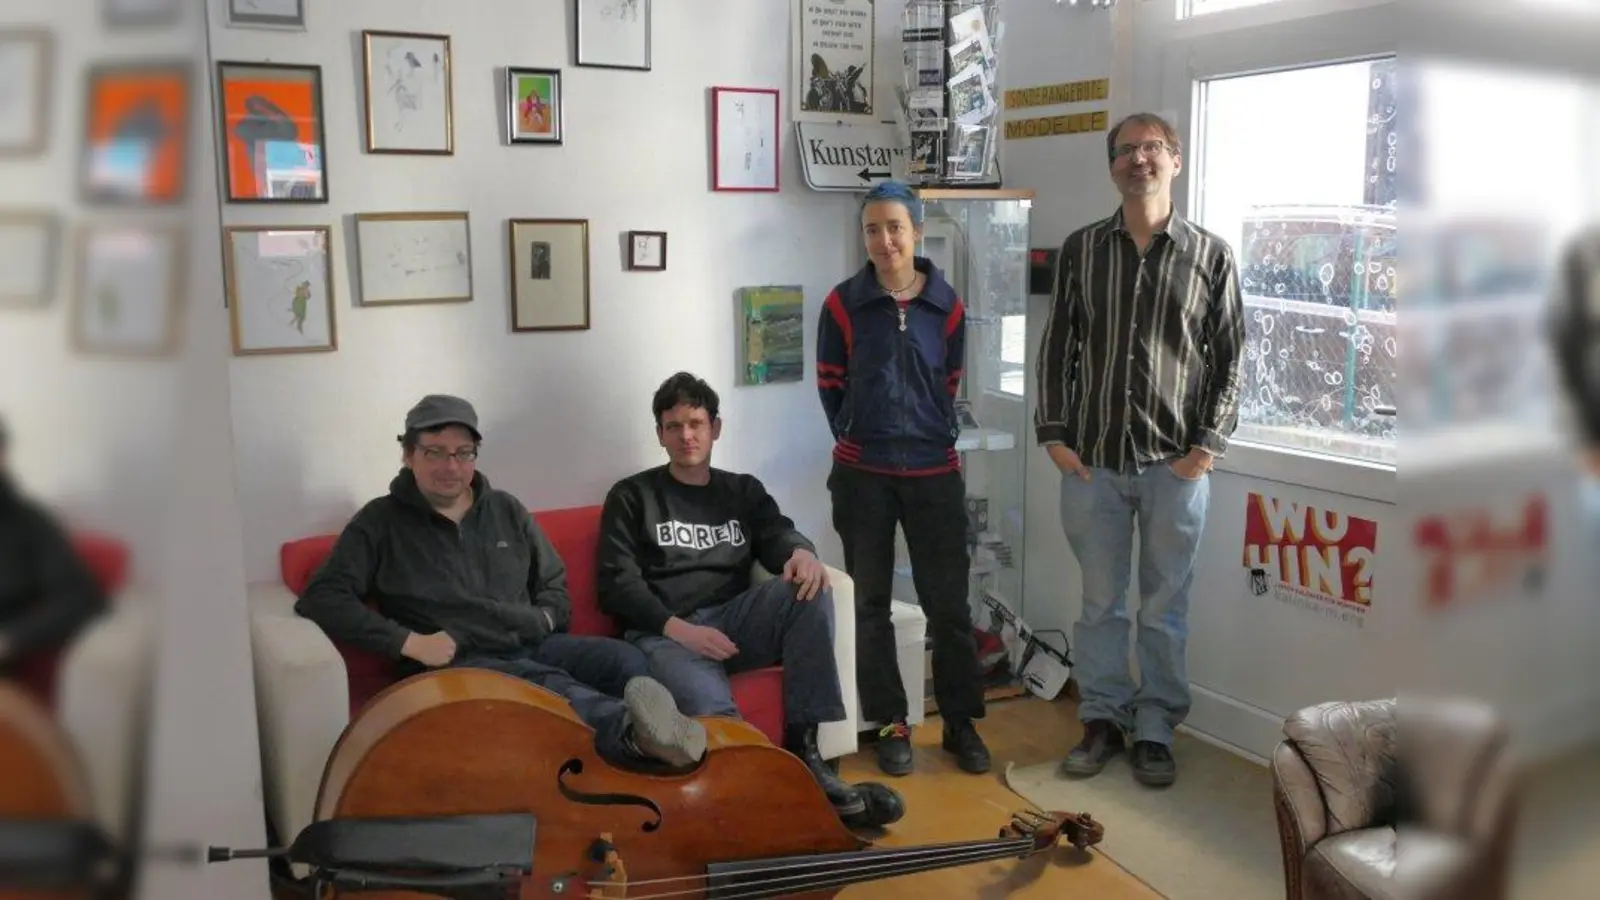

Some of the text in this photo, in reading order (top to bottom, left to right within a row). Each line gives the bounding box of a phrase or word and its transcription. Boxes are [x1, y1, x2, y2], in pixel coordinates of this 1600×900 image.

[1007, 79, 1107, 108] SONDERANGEBOTE
[1005, 110, 1106, 139] MODELLE
[657, 519, 745, 549] BORED
